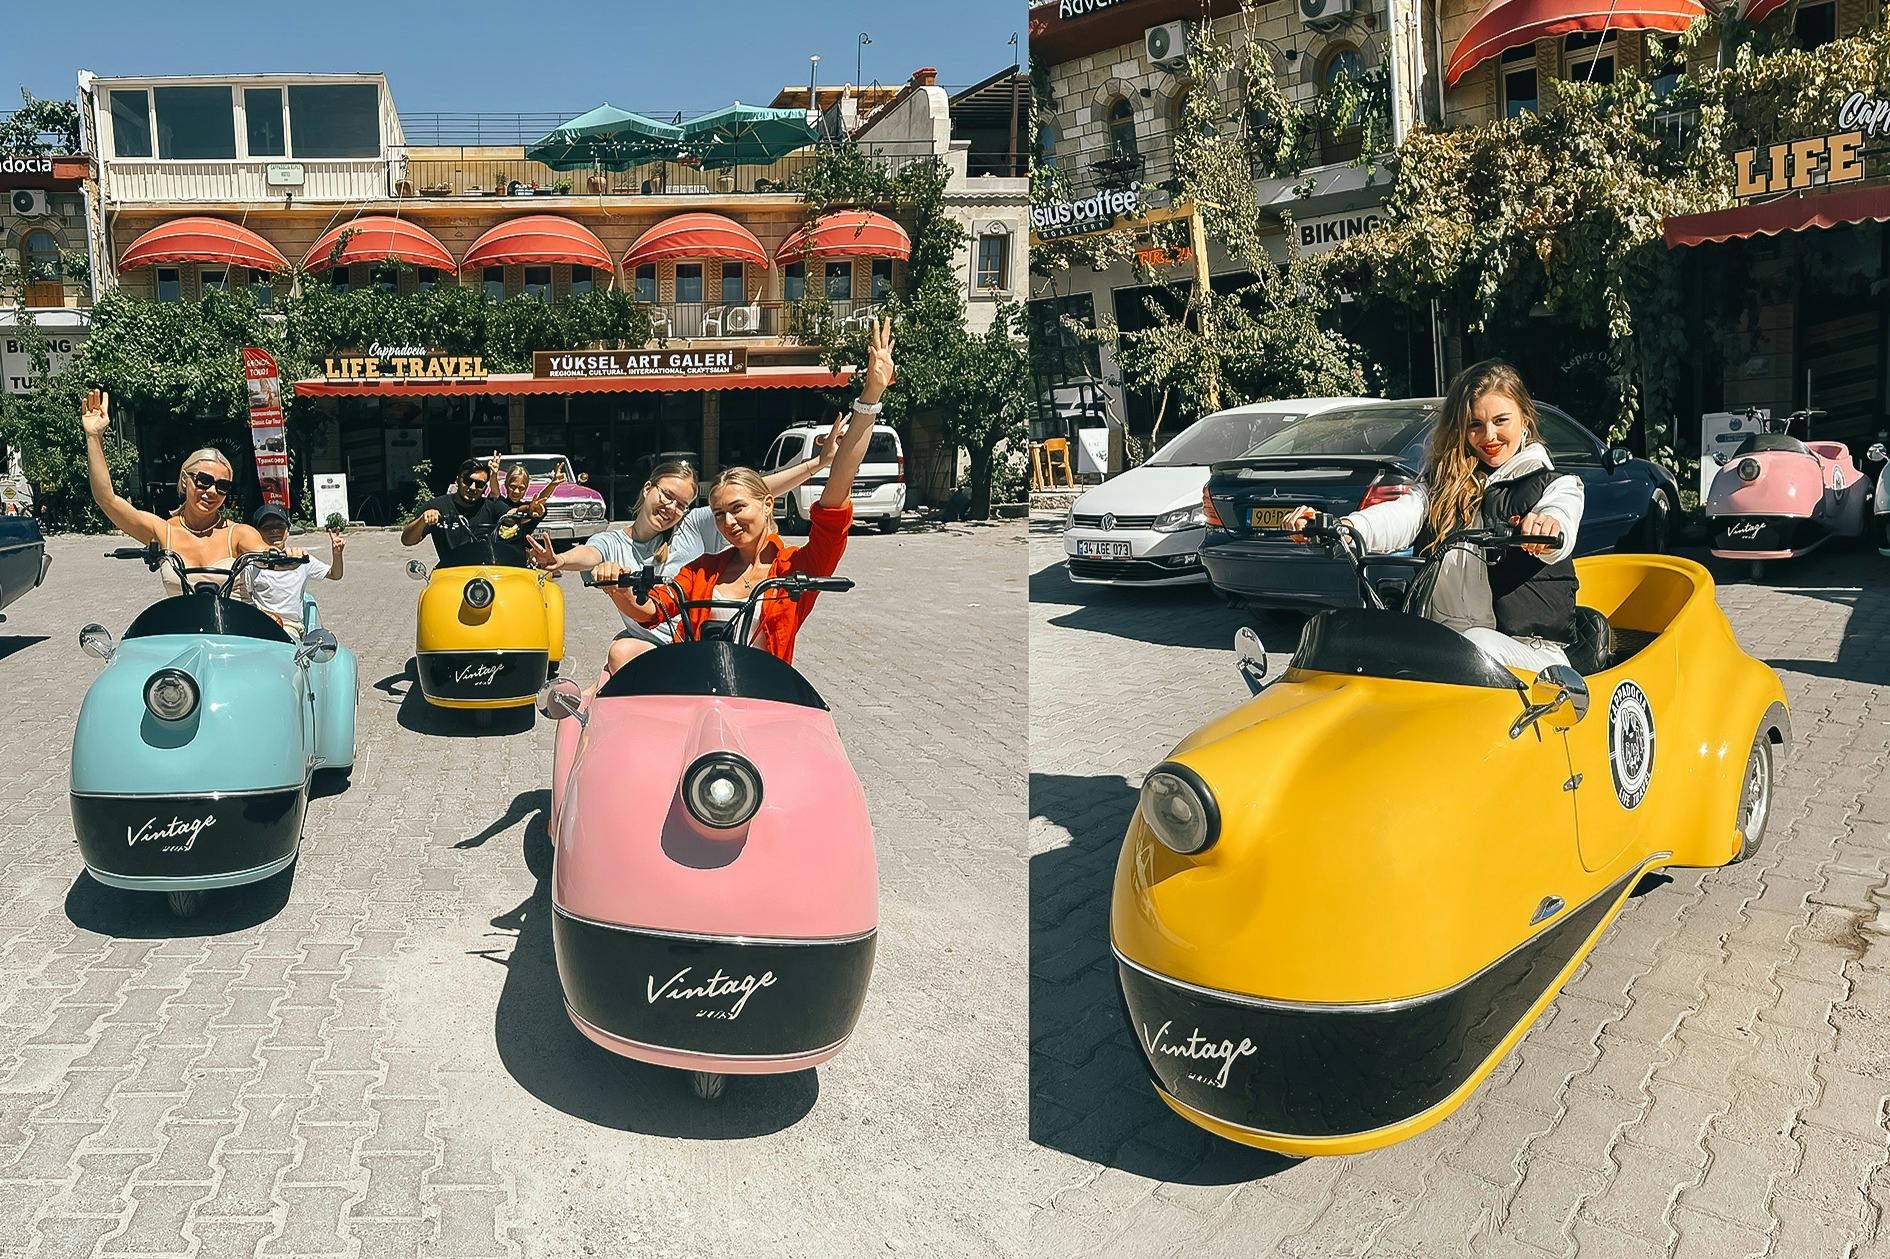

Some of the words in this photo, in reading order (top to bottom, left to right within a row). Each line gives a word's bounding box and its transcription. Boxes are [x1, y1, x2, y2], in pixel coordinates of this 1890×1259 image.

[0, 156, 52, 173] docia
[1735, 131, 1862, 196] LIFE
[1073, 189, 1137, 221] coffee
[1042, 222, 1104, 238] ROASTERY
[1301, 215, 1380, 246] BIKING
[369, 343, 427, 360] Cappadocia
[550, 355, 619, 369] YÜKSEL
[627, 355, 661, 368] ART
[669, 350, 733, 367] GALERİ
[325, 358, 379, 378] LIFE
[392, 357, 488, 377] TRAVEL
[628, 367, 685, 375] INTERNATIONAL,
[687, 366, 730, 374] CRAFTSMAN
[1728, 522, 1767, 539] Vintage
[1083, 542, 1093, 554] 34
[1095, 543, 1111, 555] AGE
[1113, 544, 1129, 556] 073
[455, 663, 504, 685] Vintage
[1610, 684, 1647, 724] CAPPADOCIA
[127, 814, 217, 851] Vintage
[647, 966, 778, 1020] Vintage
[1143, 1020, 1258, 1089] Vintage
